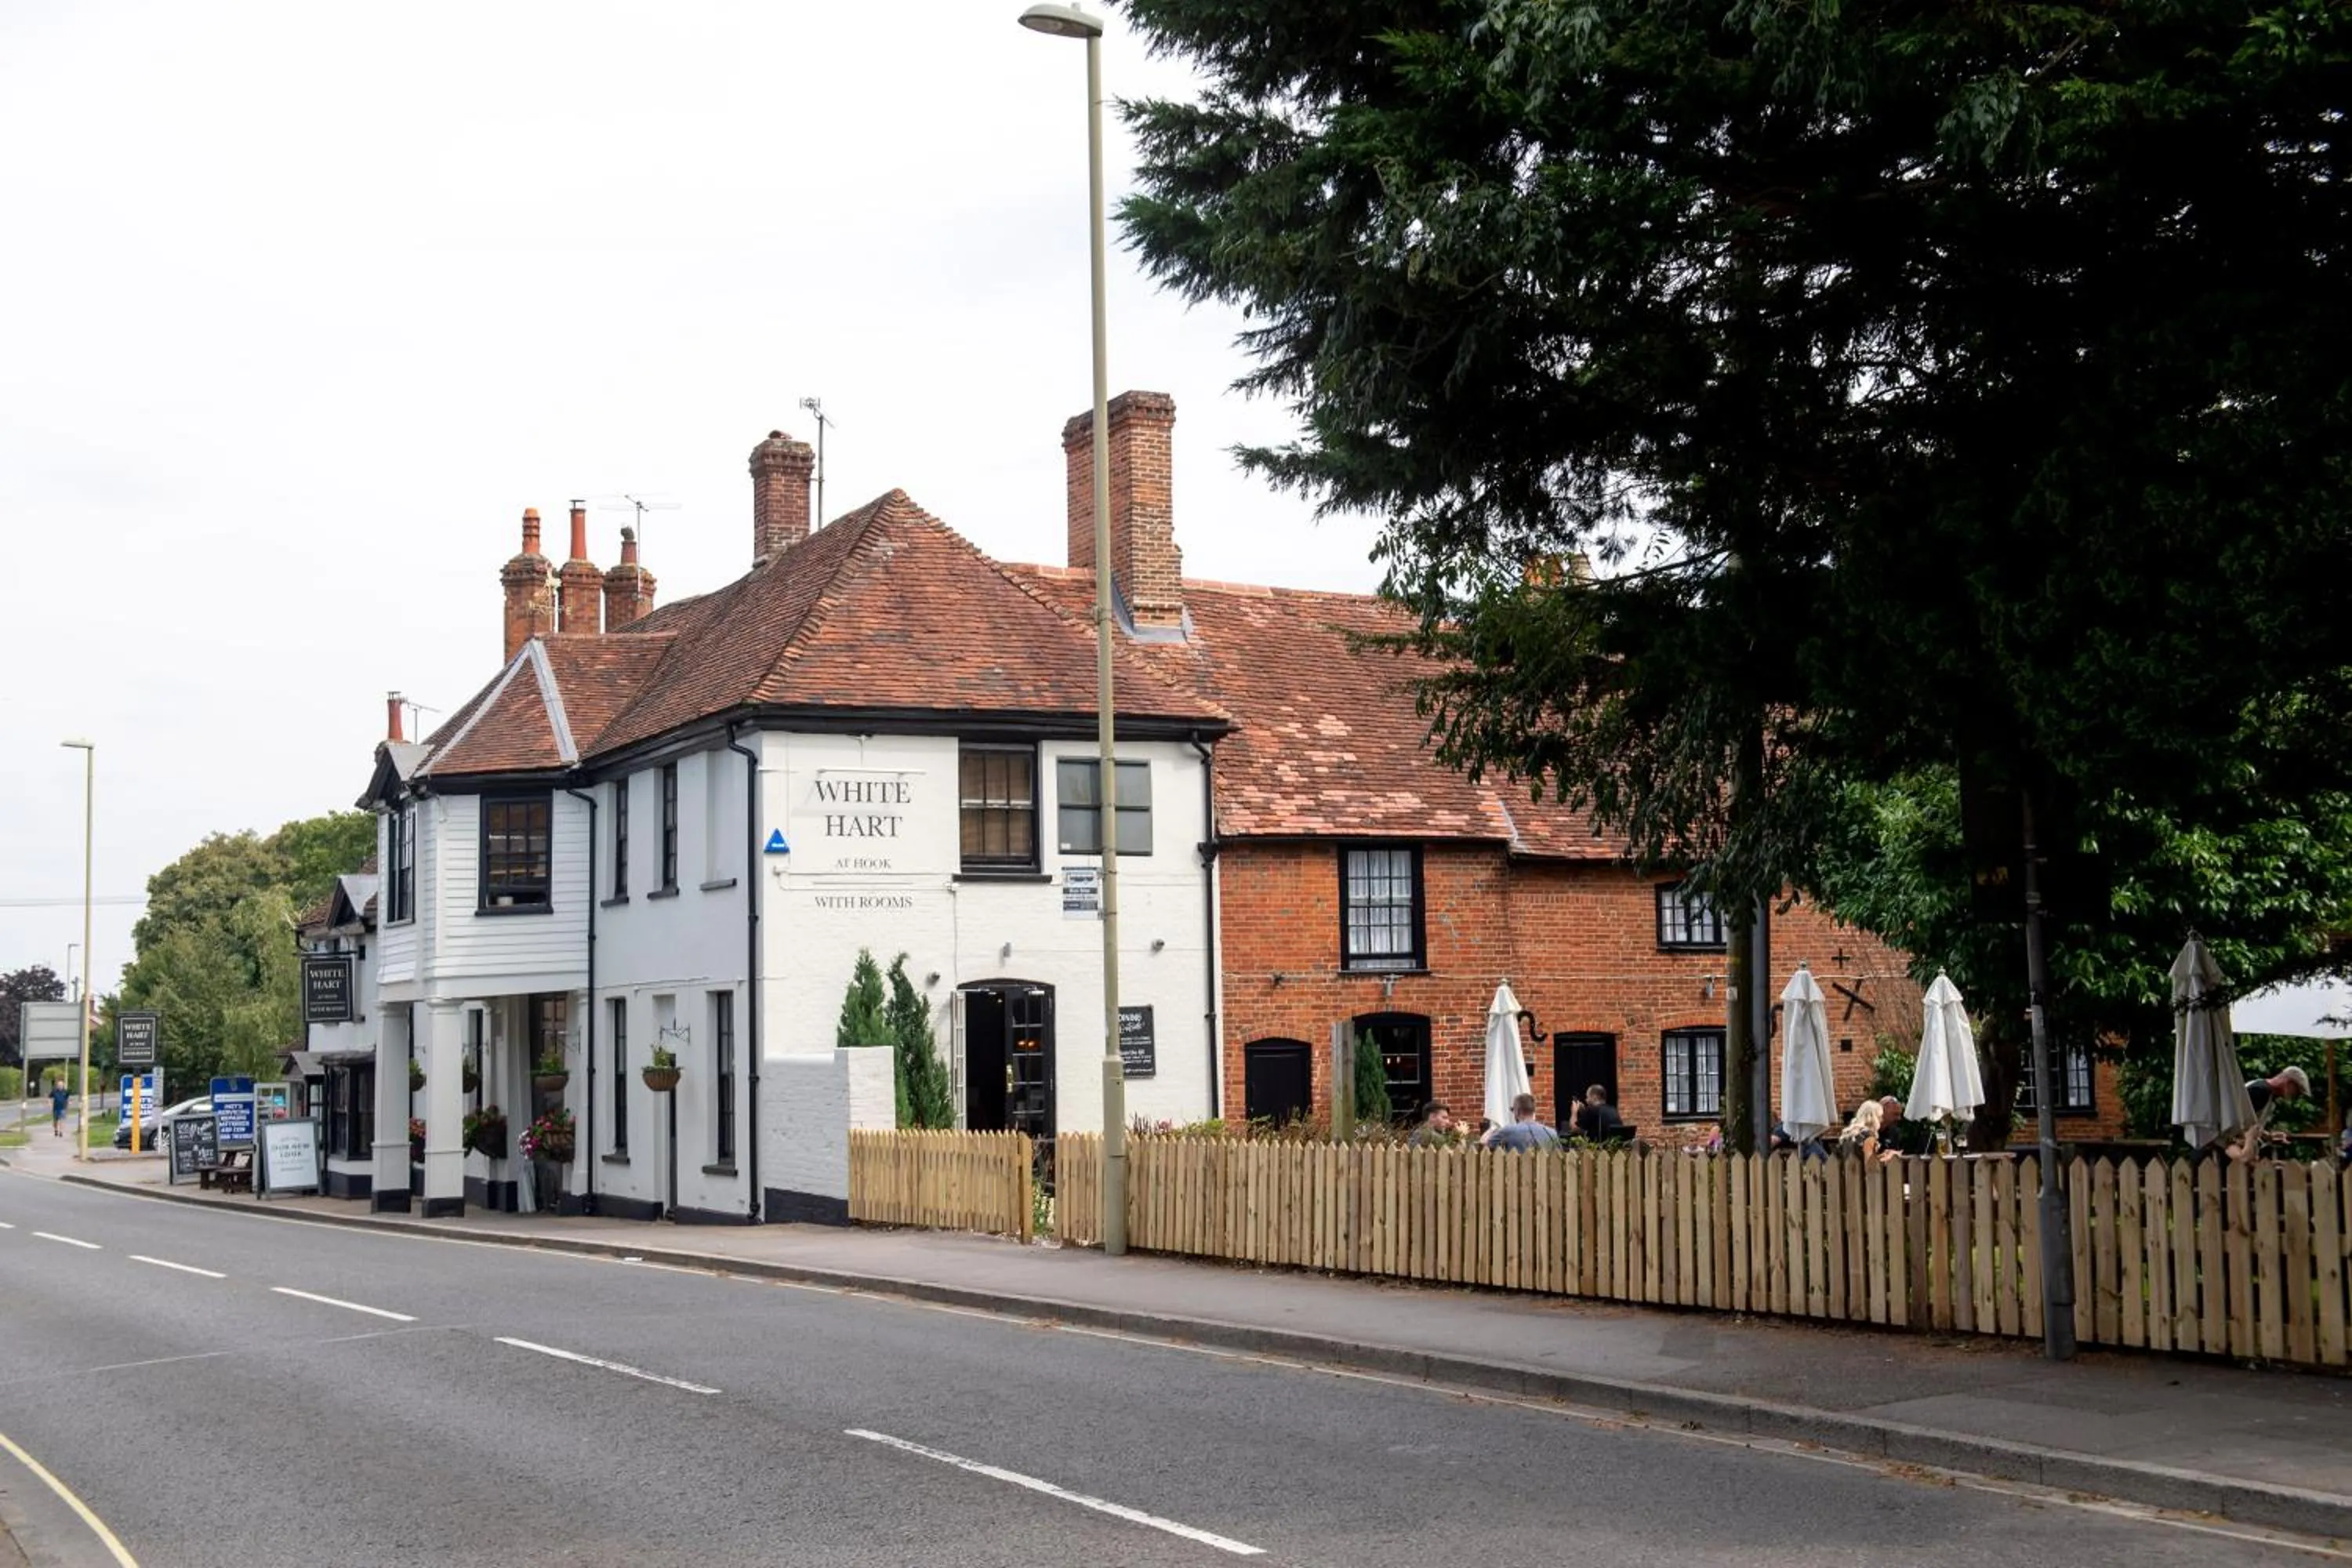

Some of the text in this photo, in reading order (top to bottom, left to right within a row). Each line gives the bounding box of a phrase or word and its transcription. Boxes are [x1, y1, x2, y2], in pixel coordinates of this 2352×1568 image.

[815, 780, 911, 804] WHITE
[826, 815, 903, 837] HART
[836, 858, 891, 869] AT HOOK
[815, 896, 913, 909] WITH ROOMS
[310, 968, 345, 978] WHITE
[314, 980, 342, 989] HART
